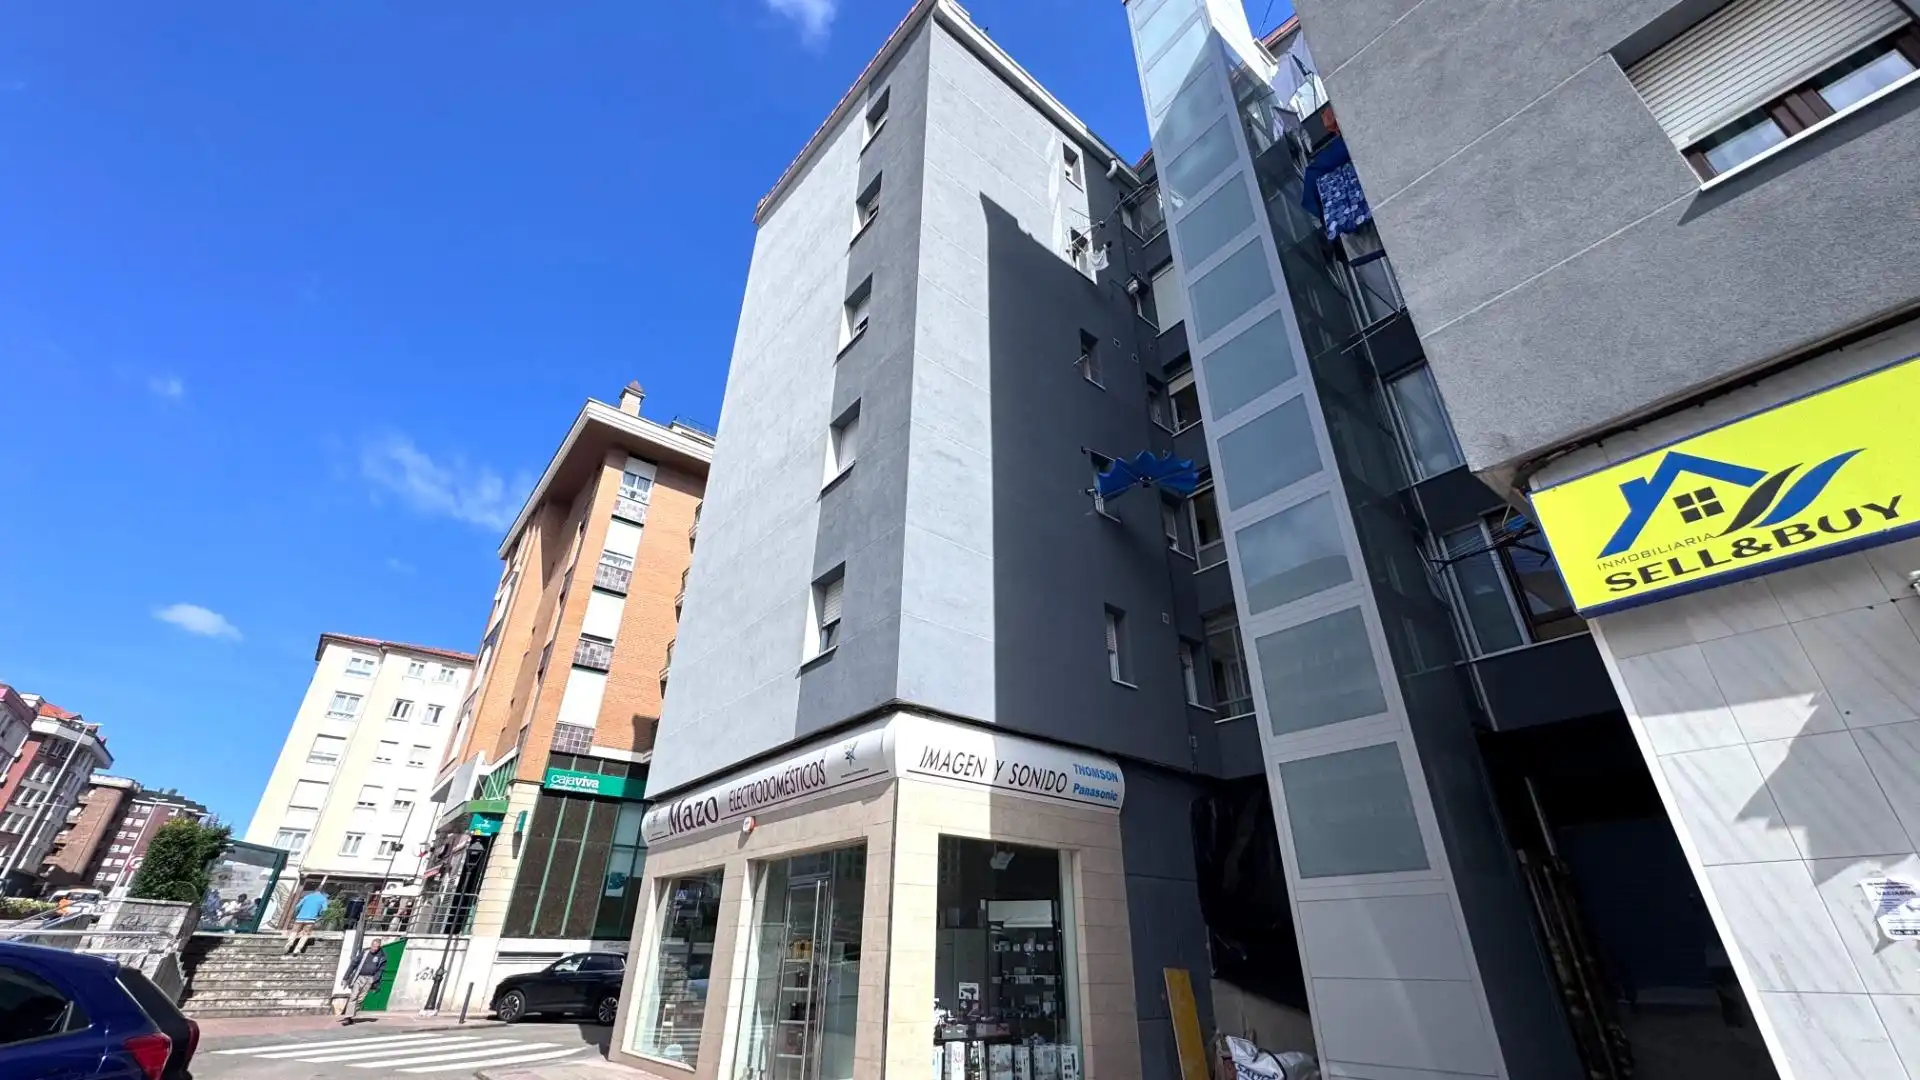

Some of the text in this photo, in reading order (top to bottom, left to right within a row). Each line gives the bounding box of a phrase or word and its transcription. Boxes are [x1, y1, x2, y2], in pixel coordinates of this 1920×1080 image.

[1597, 532, 1717, 571] INMOBILIARIA
[1604, 494, 1903, 593] SELL&BUY
[550, 773, 600, 789] cajaviva
[919, 745, 1068, 794] IMAGEN Y SONIDO
[1072, 763, 1119, 783] THOMSON
[668, 758, 826, 836] Mazo ELECTRODOMÉSTICOS
[1072, 782, 1119, 802] Panasonic
